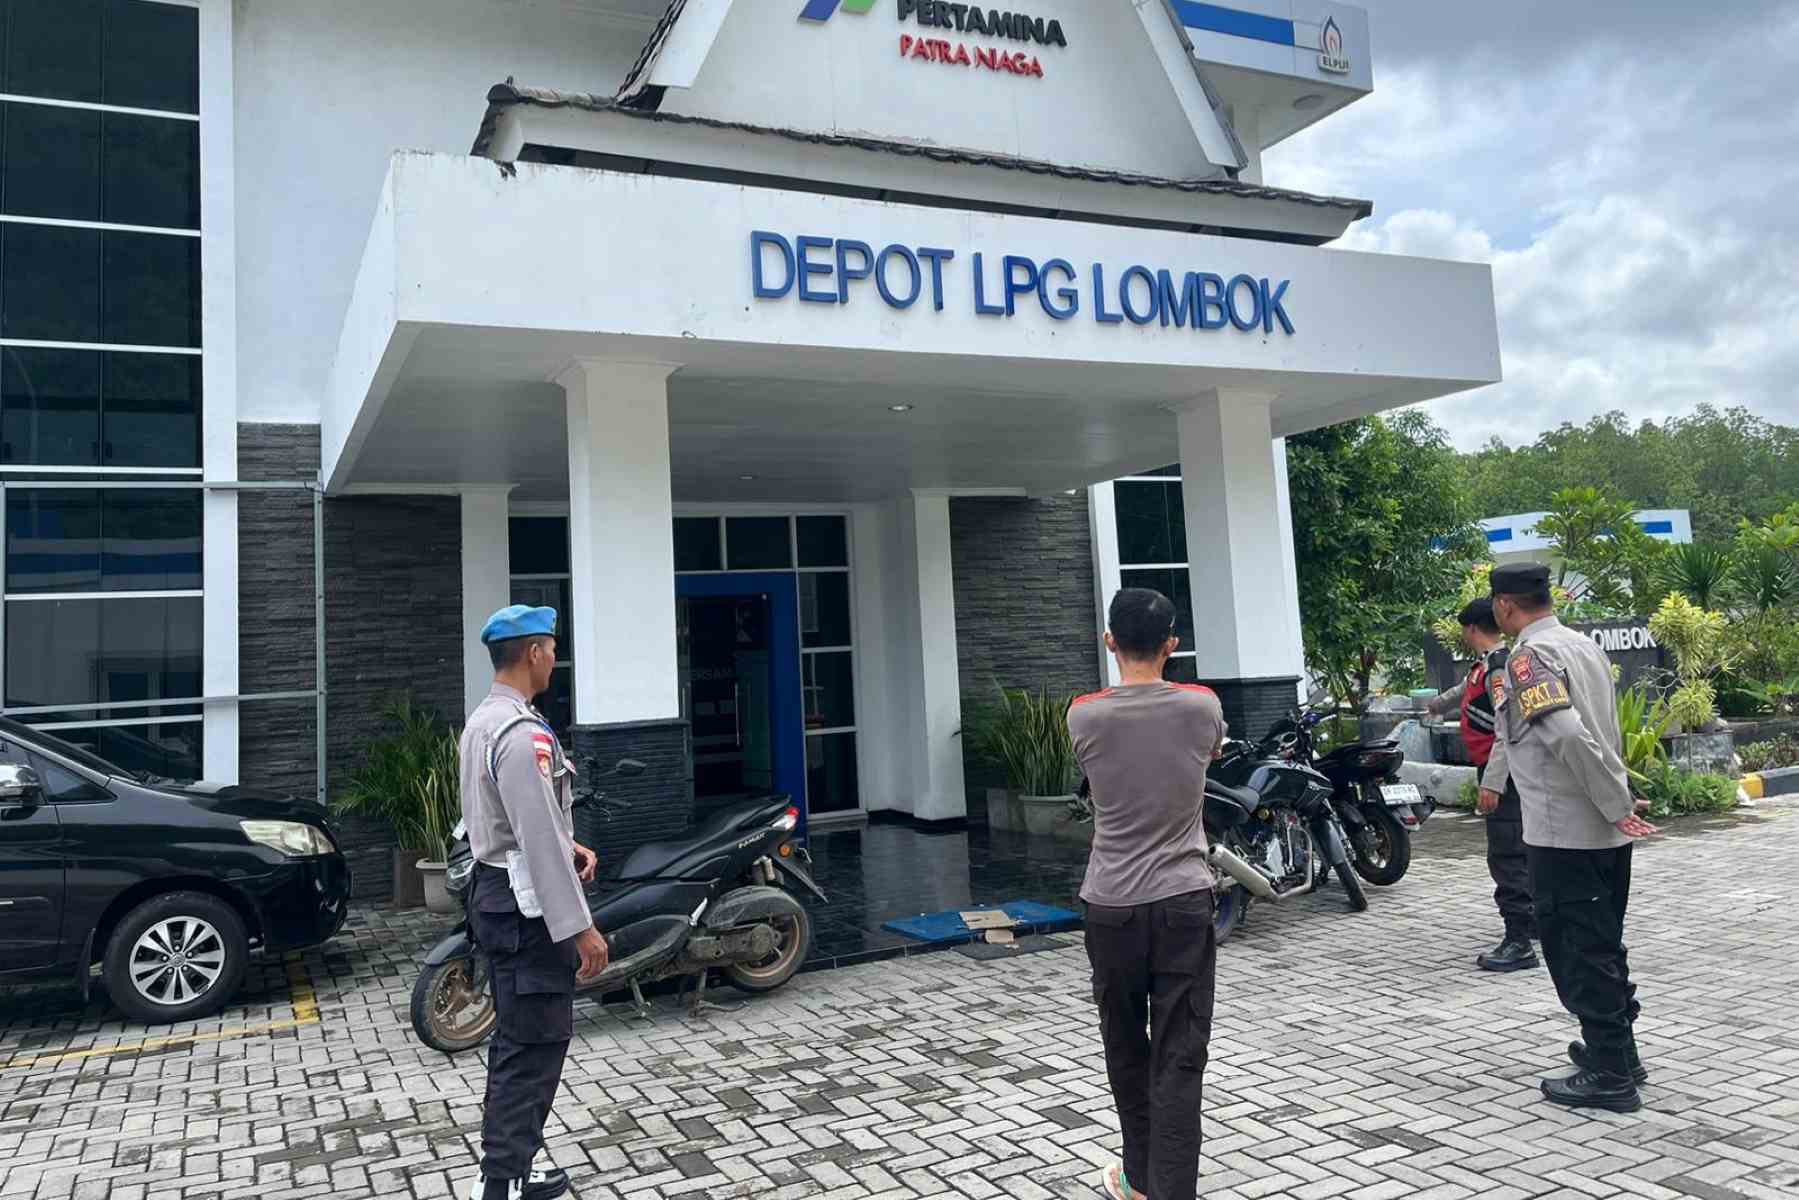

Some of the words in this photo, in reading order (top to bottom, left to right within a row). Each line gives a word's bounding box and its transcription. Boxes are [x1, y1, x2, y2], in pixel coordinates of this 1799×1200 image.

[897, 0, 1068, 48] PERTAMINA
[899, 33, 971, 67] PATRA
[974, 46, 1044, 78] NIAGA
[750, 230, 955, 312] DEPOT
[972, 252, 1080, 321] LPG
[1092, 262, 1297, 335] LOMBOK
